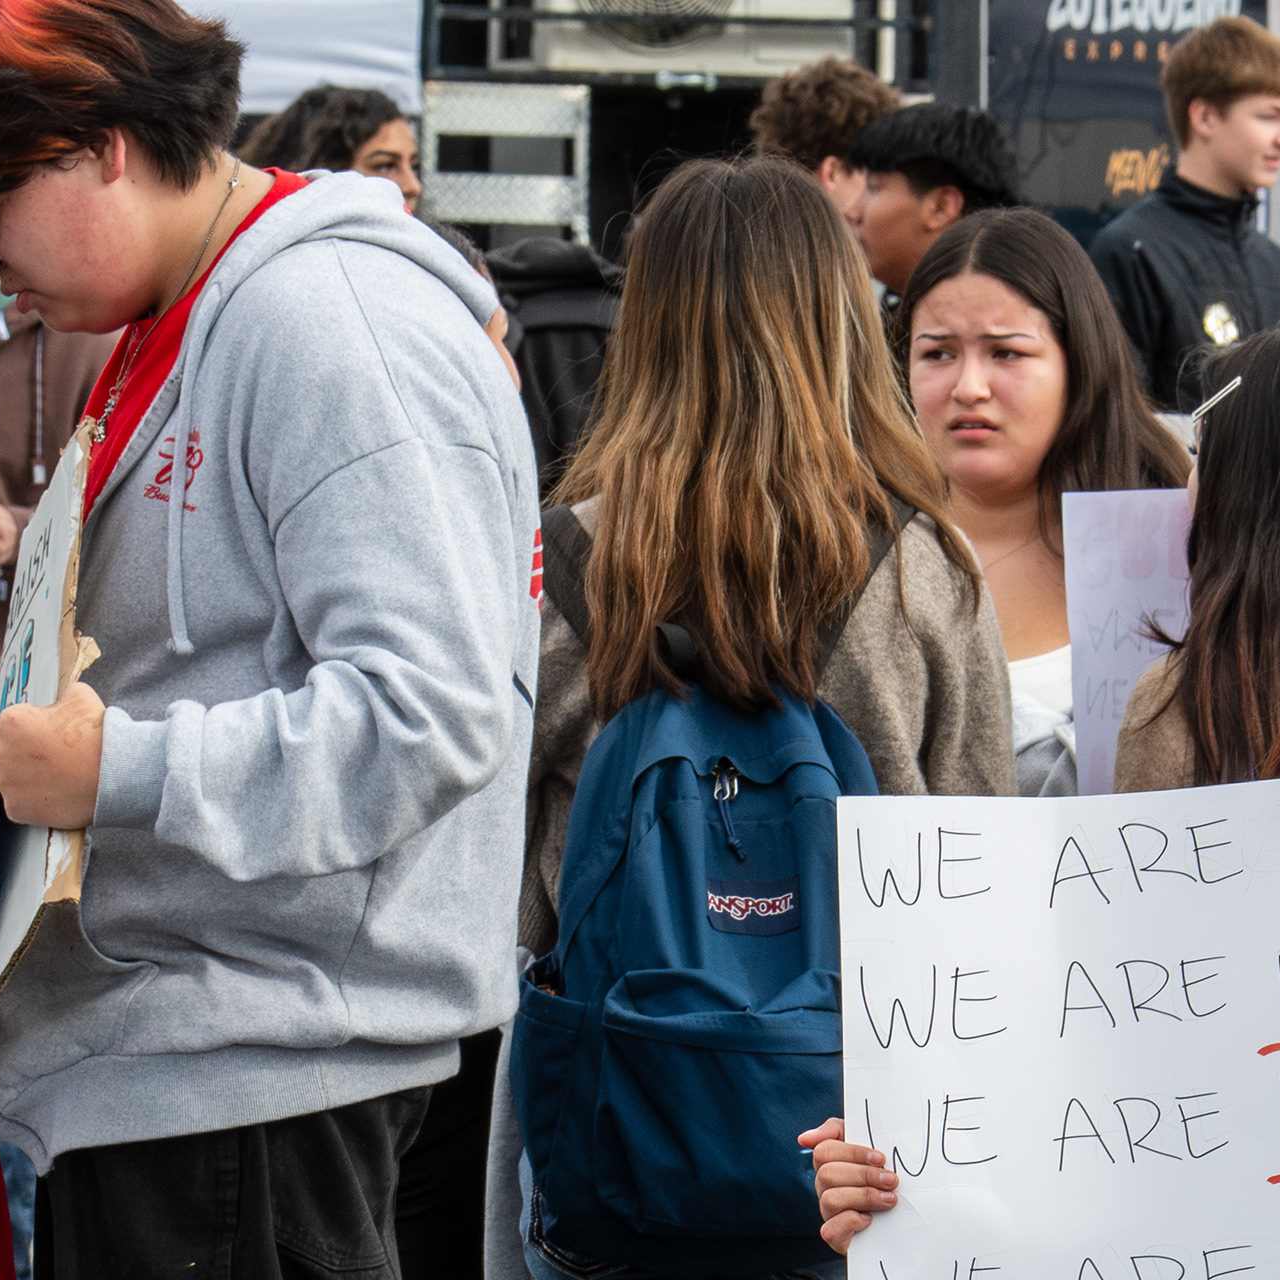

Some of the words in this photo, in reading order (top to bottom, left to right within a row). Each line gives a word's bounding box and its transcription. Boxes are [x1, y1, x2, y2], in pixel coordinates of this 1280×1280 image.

[1064, 38, 1171, 62] EXPRE
[8, 518, 53, 632] OLISH
[707, 891, 793, 920] ANSPORT
[856, 826, 991, 908] WE
[1049, 818, 1243, 908] ARE
[860, 964, 1008, 1048] WE
[1060, 955, 1227, 1038] ARE
[865, 1093, 997, 1176] WE
[1053, 1091, 1228, 1172] ARE
